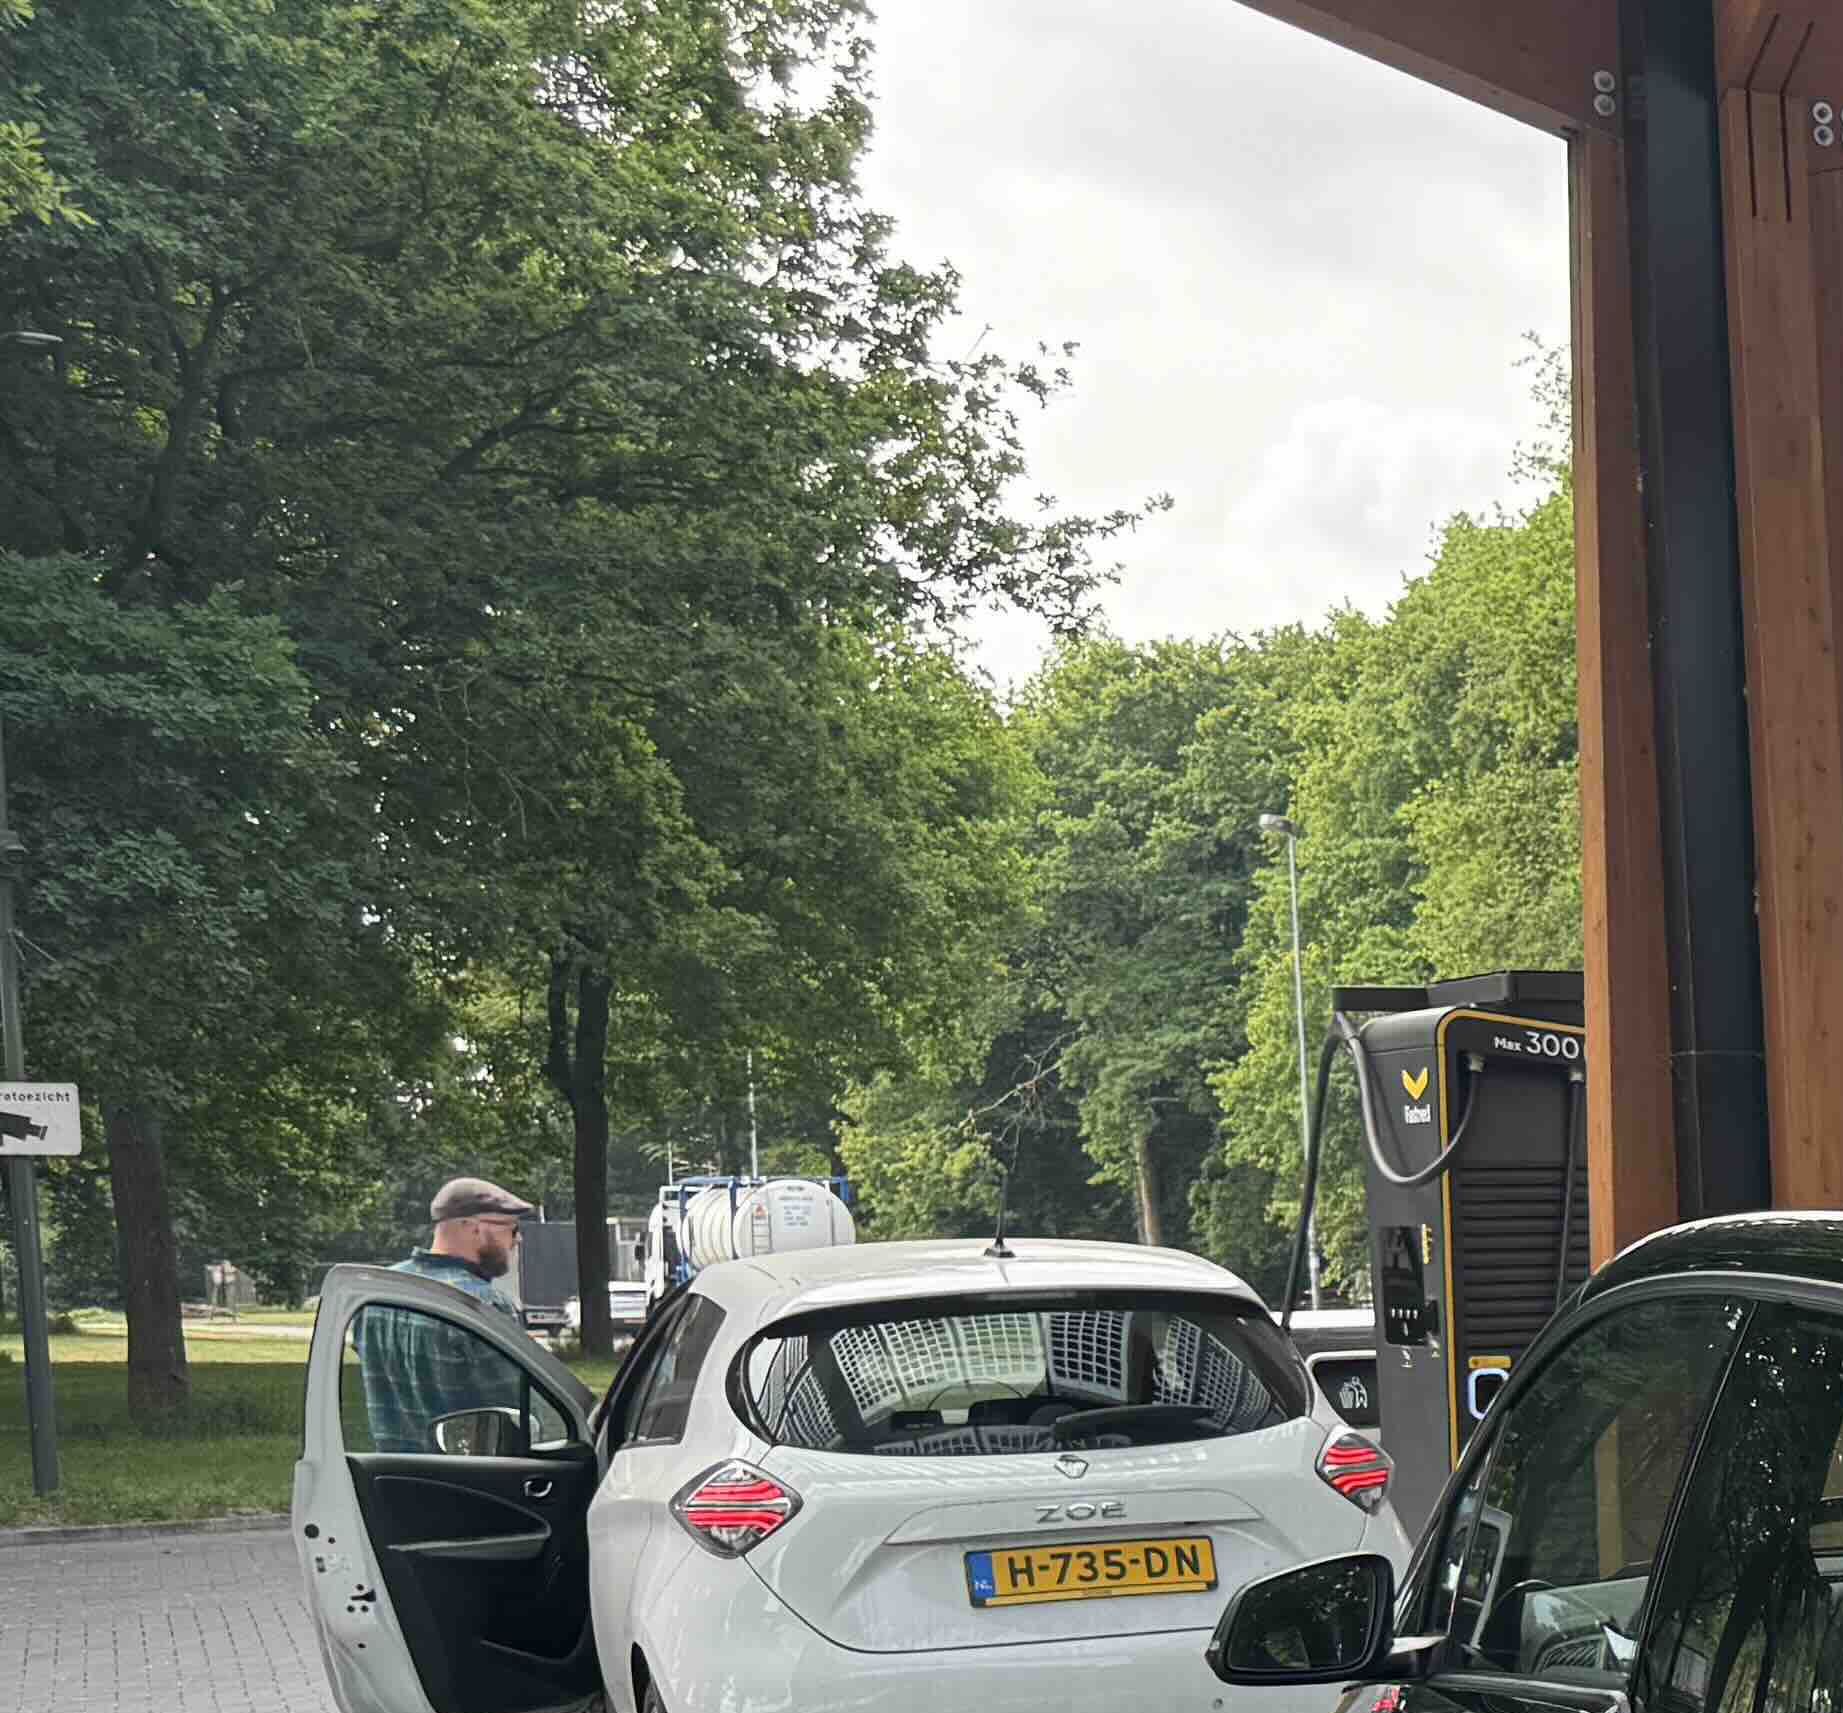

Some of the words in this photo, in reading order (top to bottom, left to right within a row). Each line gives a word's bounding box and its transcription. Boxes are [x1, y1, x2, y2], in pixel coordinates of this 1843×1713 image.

[1493, 1036, 1522, 1053] Max
[1524, 1030, 1580, 1059] 300
[0, 1091, 71, 1103] atoezicht
[1033, 1500, 1128, 1524] ZOE
[1006, 1544, 1202, 1588] H-735-DN
